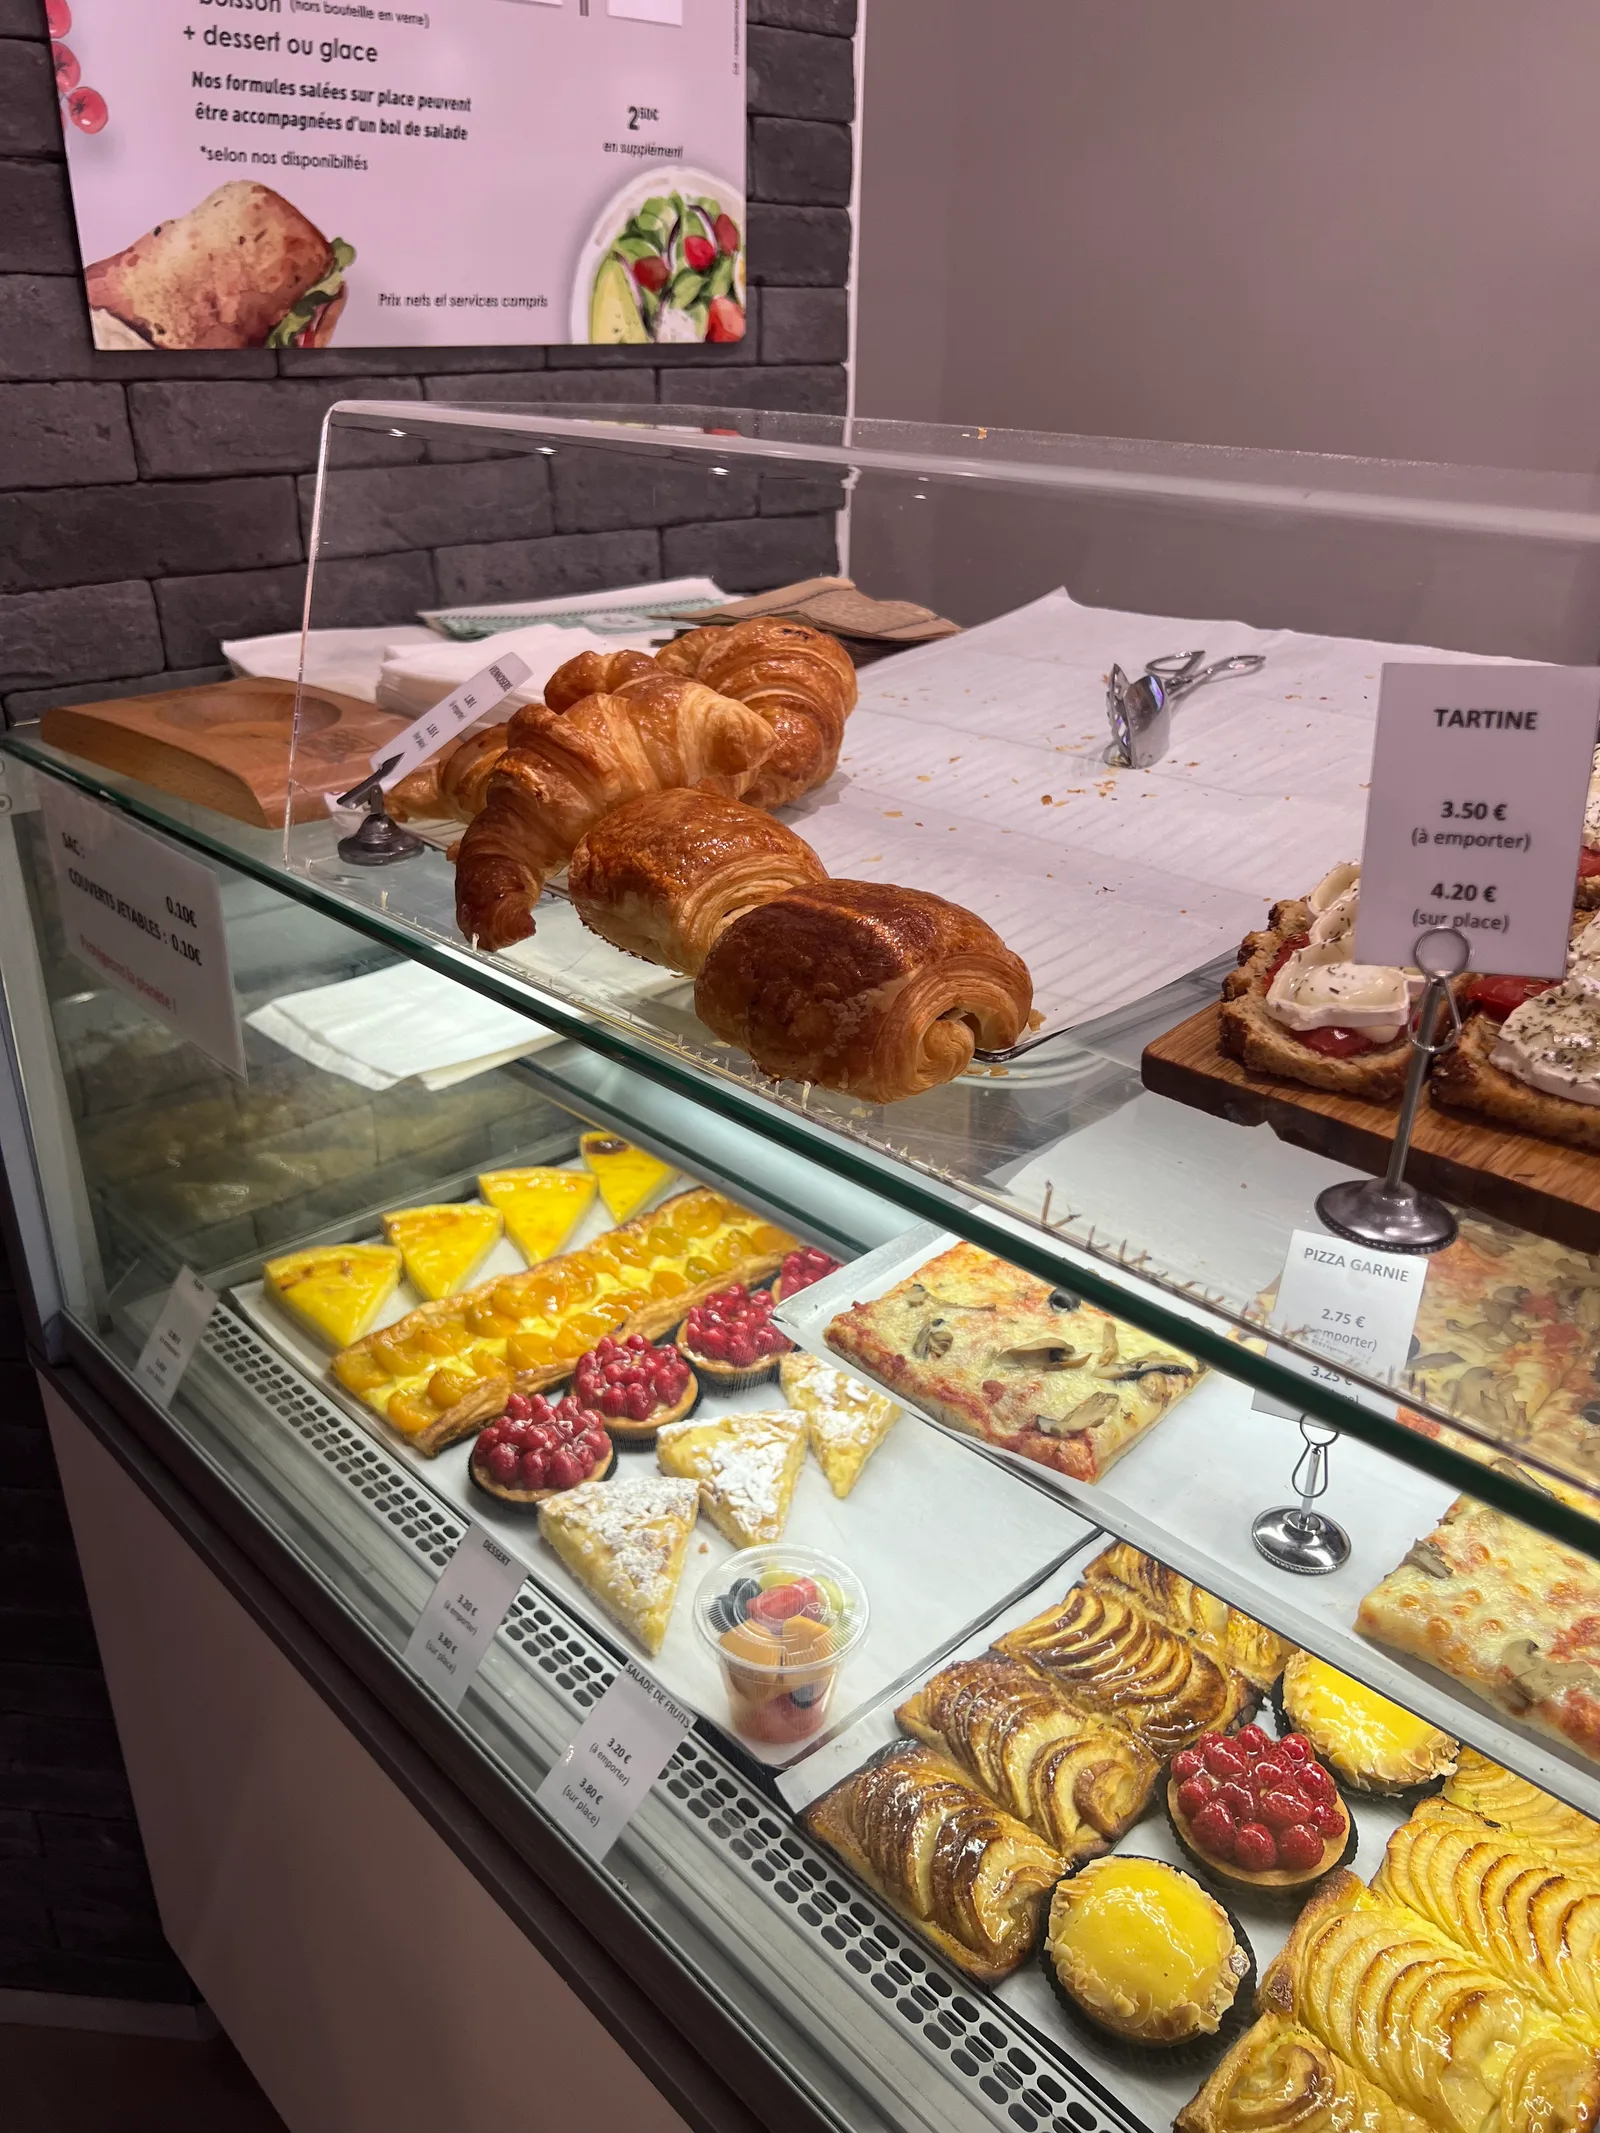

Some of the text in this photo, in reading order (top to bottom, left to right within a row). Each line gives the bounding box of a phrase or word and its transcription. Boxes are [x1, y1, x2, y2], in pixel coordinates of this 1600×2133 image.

[323, 4, 375, 19] bouteille
[377, 12, 394, 21] en
[183, 24, 379, 63] + dessert ou glace
[191, 71, 471, 112] Nos formules salées sur place peuvent
[195, 102, 469, 140] être accompagnées d'un bol de salade
[251, 151, 277, 165] nos
[602, 141, 684, 159] en supplément
[378, 292, 549, 311] Prix nets et services compris
[1433, 708, 1539, 731] TARTINE
[1440, 800, 1508, 822] 3.50 €
[1411, 827, 1532, 853] (à emporter)
[62, 832, 80, 856] SAC
[165, 896, 197, 928] 0.10€
[1430, 883, 1498, 903] 4.20 €
[68, 867, 117, 912] COUVERTS
[116, 898, 161, 940] JETABLES
[171, 933, 203, 967] 0.10€
[1412, 908, 1511, 934] (sur place)
[1303, 1247, 1409, 1283] PIZZA GARNIE
[1321, 1308, 1366, 1329] 2.75 €
[1310, 1365, 1341, 1383] 3.25
[482, 1539, 511, 1567] DESSERT
[449, 1606, 478, 1637] emporter)
[625, 1664, 691, 1729] SALADE DE FRUITS
[606, 1737, 633, 1766] 3.20 €
[595, 1751, 631, 1788] emporter)
[579, 1777, 605, 1806] 3.80 €
[562, 1784, 602, 1829] (sur place)
